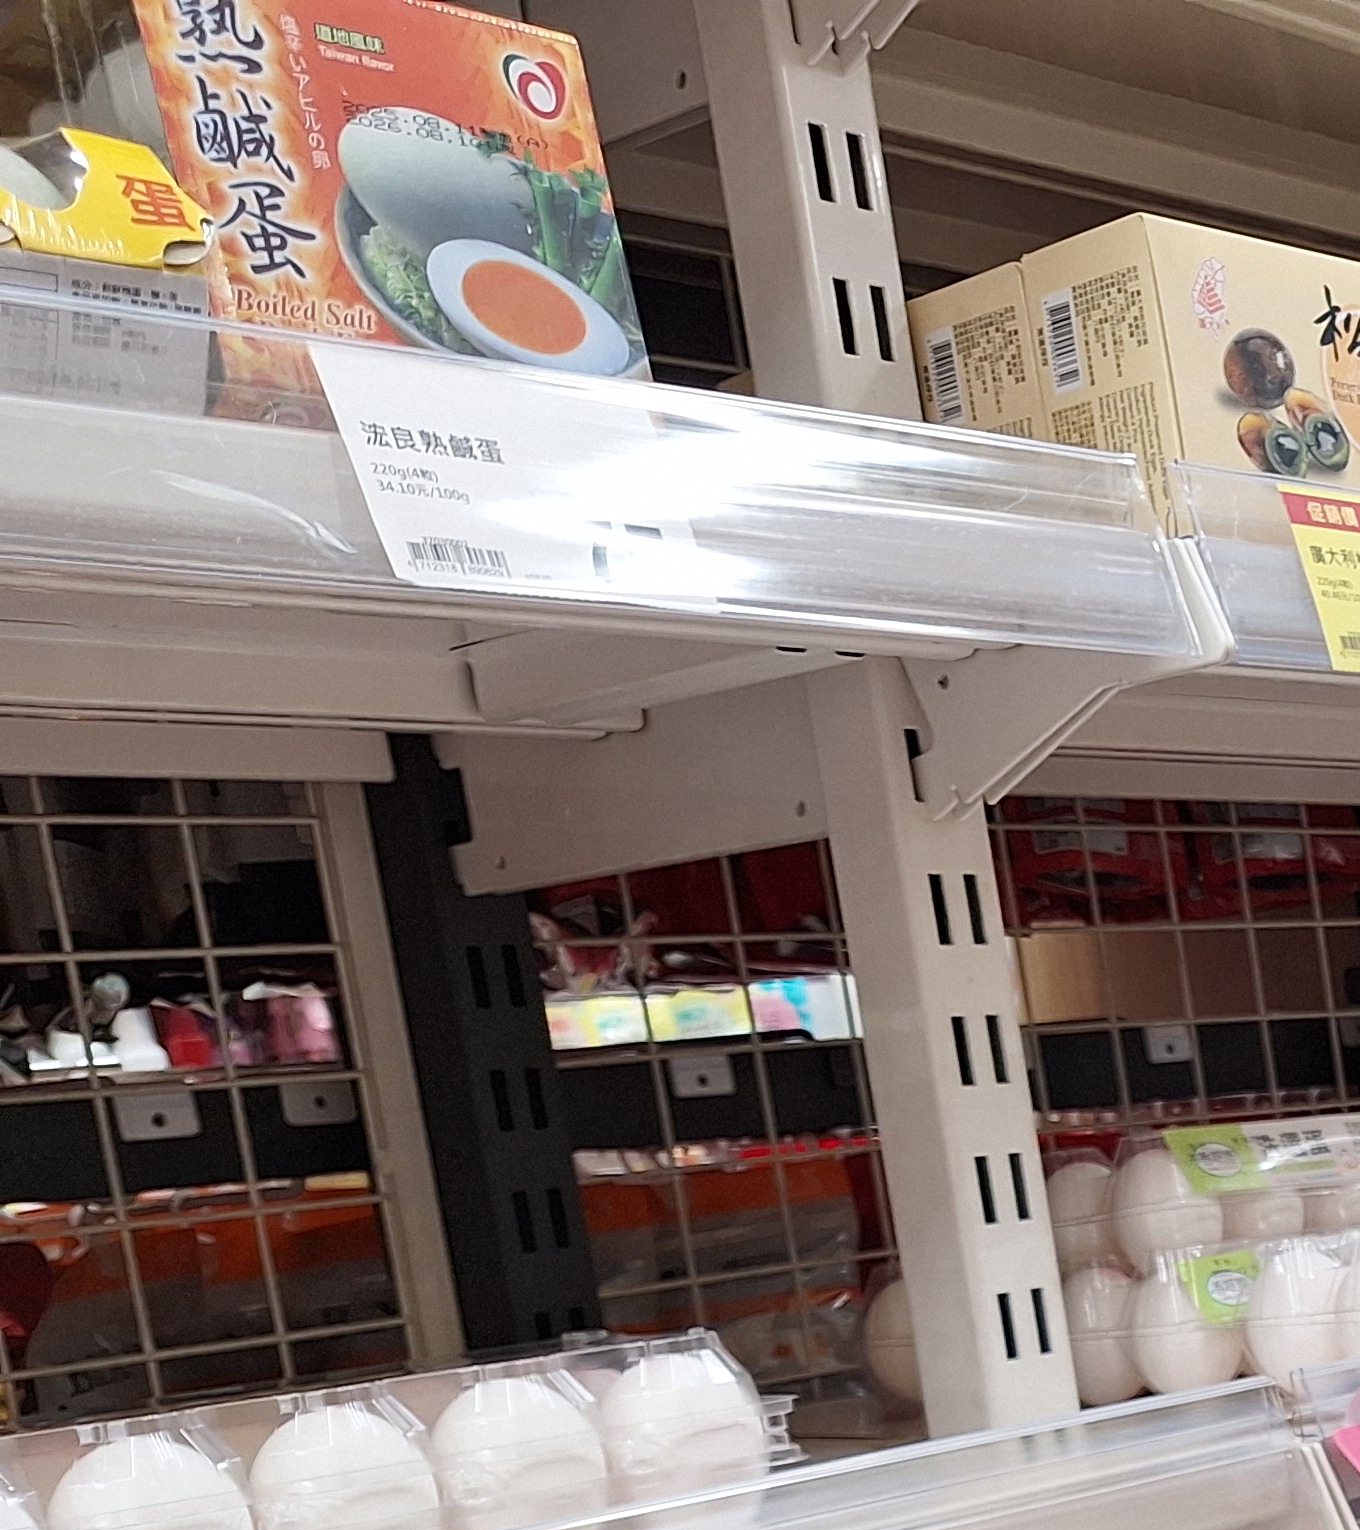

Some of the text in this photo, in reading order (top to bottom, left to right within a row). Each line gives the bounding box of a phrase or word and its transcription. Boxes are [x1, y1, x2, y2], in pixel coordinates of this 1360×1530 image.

[318, 44, 361, 66] Taiwan
[121, 175, 196, 232] 蛋
[235, 288, 317, 322] Boiled
[324, 303, 377, 332] Salt
